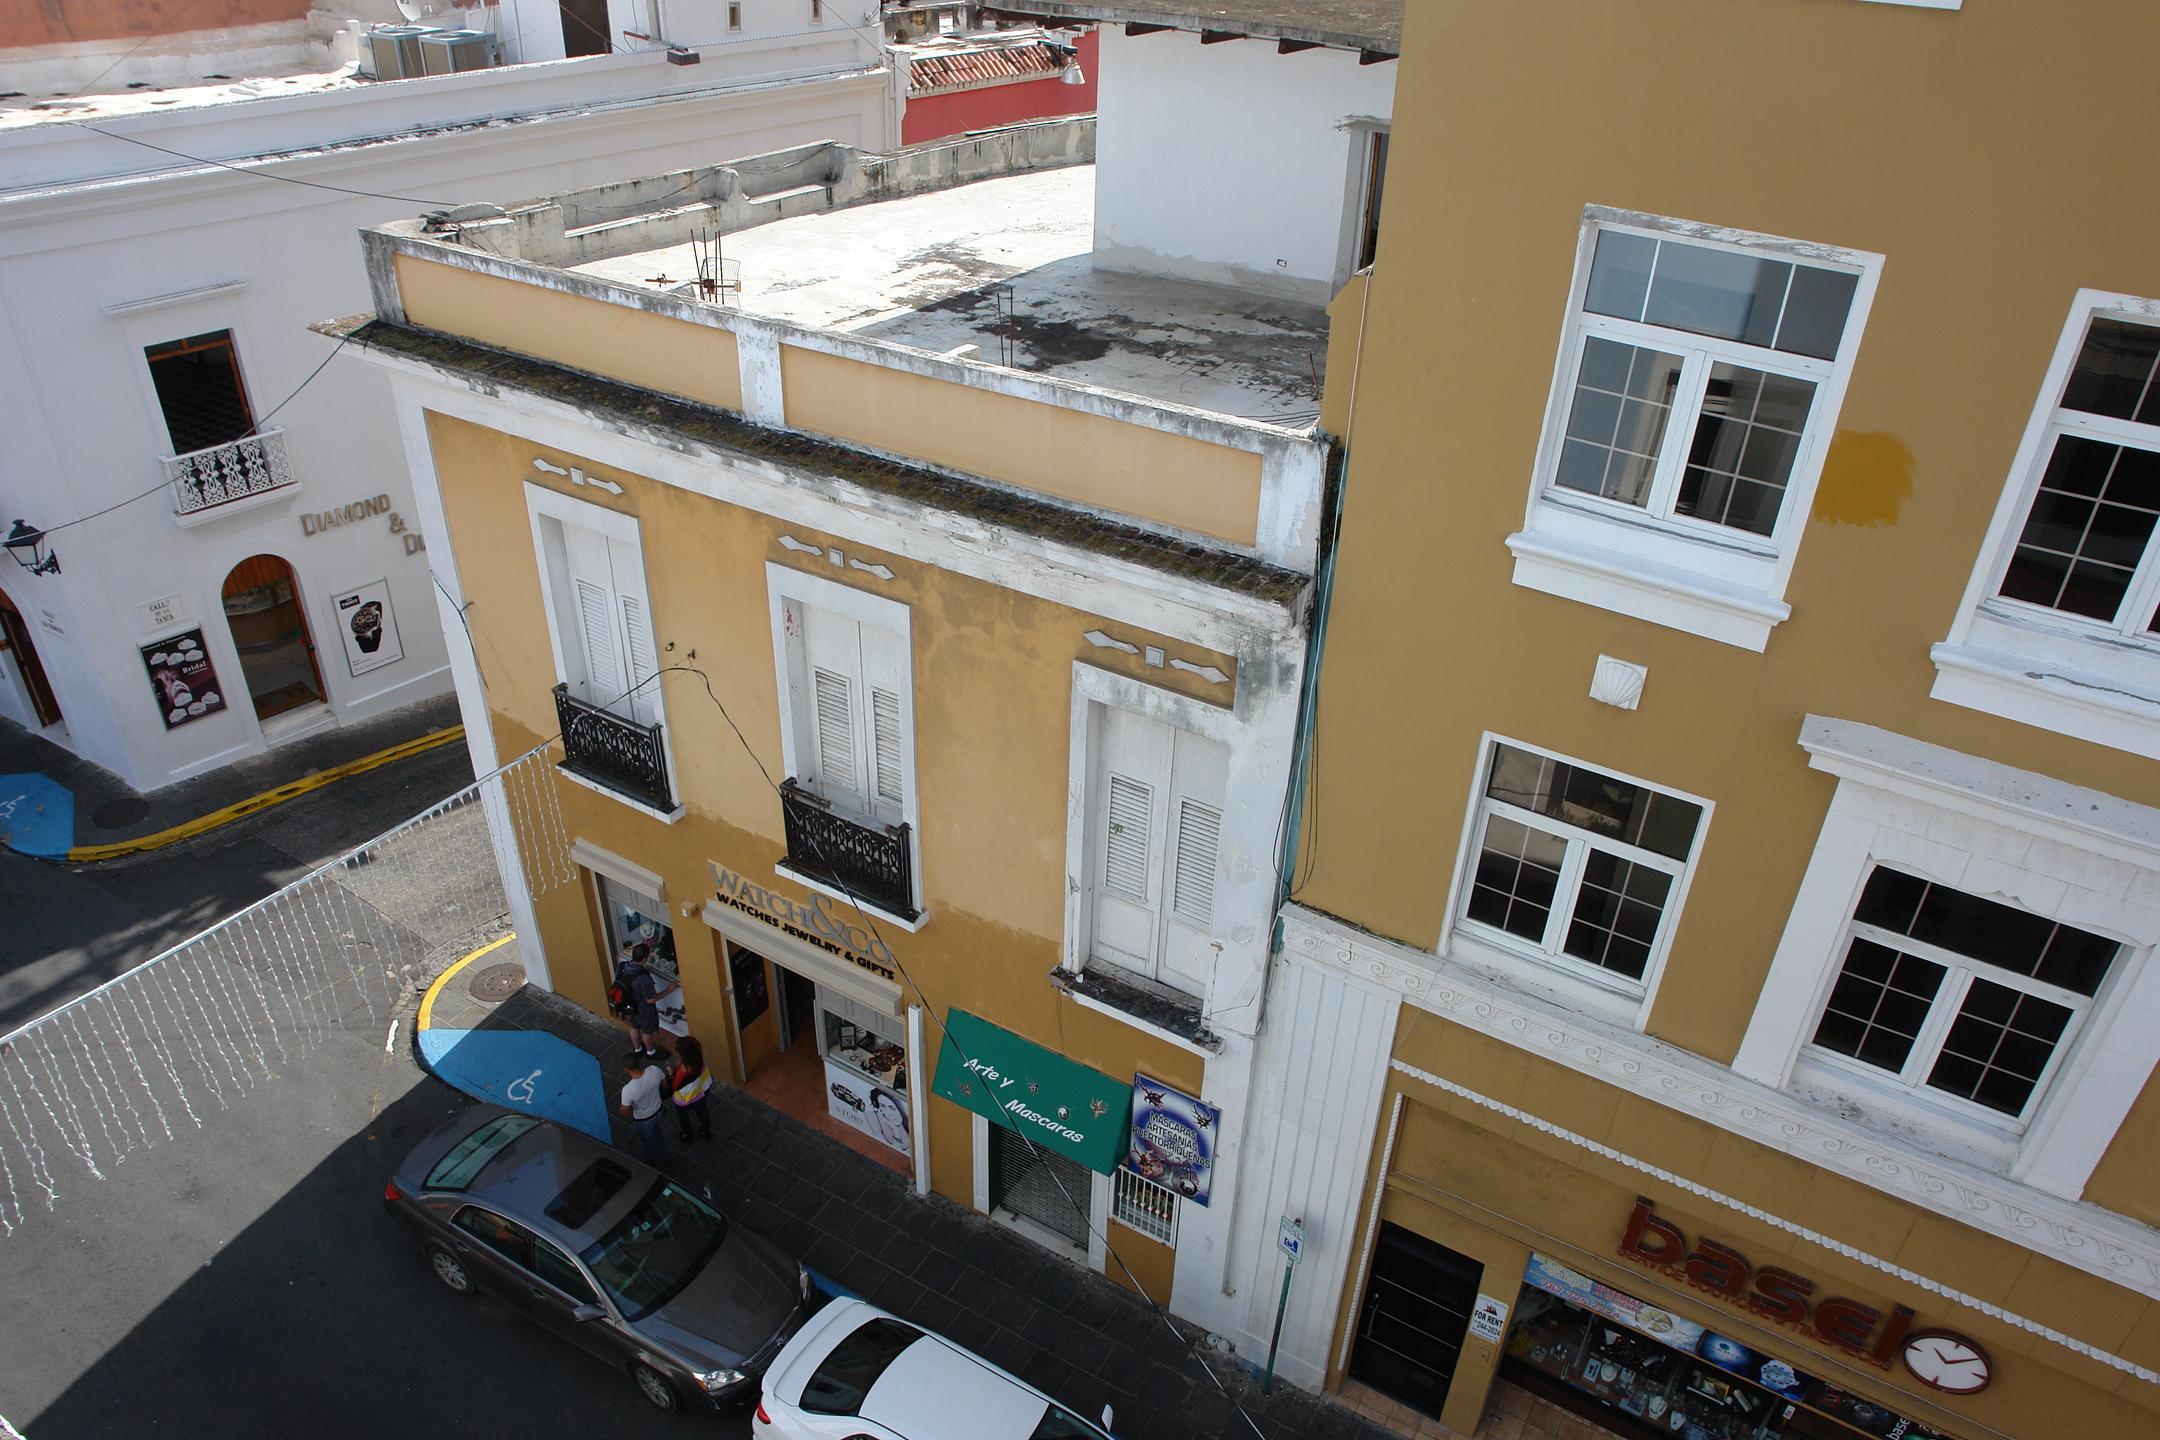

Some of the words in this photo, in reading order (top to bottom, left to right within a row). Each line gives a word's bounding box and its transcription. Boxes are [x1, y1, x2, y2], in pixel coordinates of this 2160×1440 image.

[301, 494, 391, 536] DIAMOND
[389, 512, 407, 534] &
[182, 661, 206, 674] Bridal
[716, 892, 779, 928] WATCHES
[781, 923, 842, 956] JEWELRY
[844, 951, 854, 962] &
[856, 956, 895, 980] GIFTS
[963, 1058, 1000, 1081] Arte
[1000, 1077, 1014, 1089] y
[1005, 1099, 1084, 1143] Mascaras
[1620, 1195, 1916, 1366] basel
[1474, 1310, 1487, 1322] FOR
[1487, 1315, 1504, 1328] RENT
